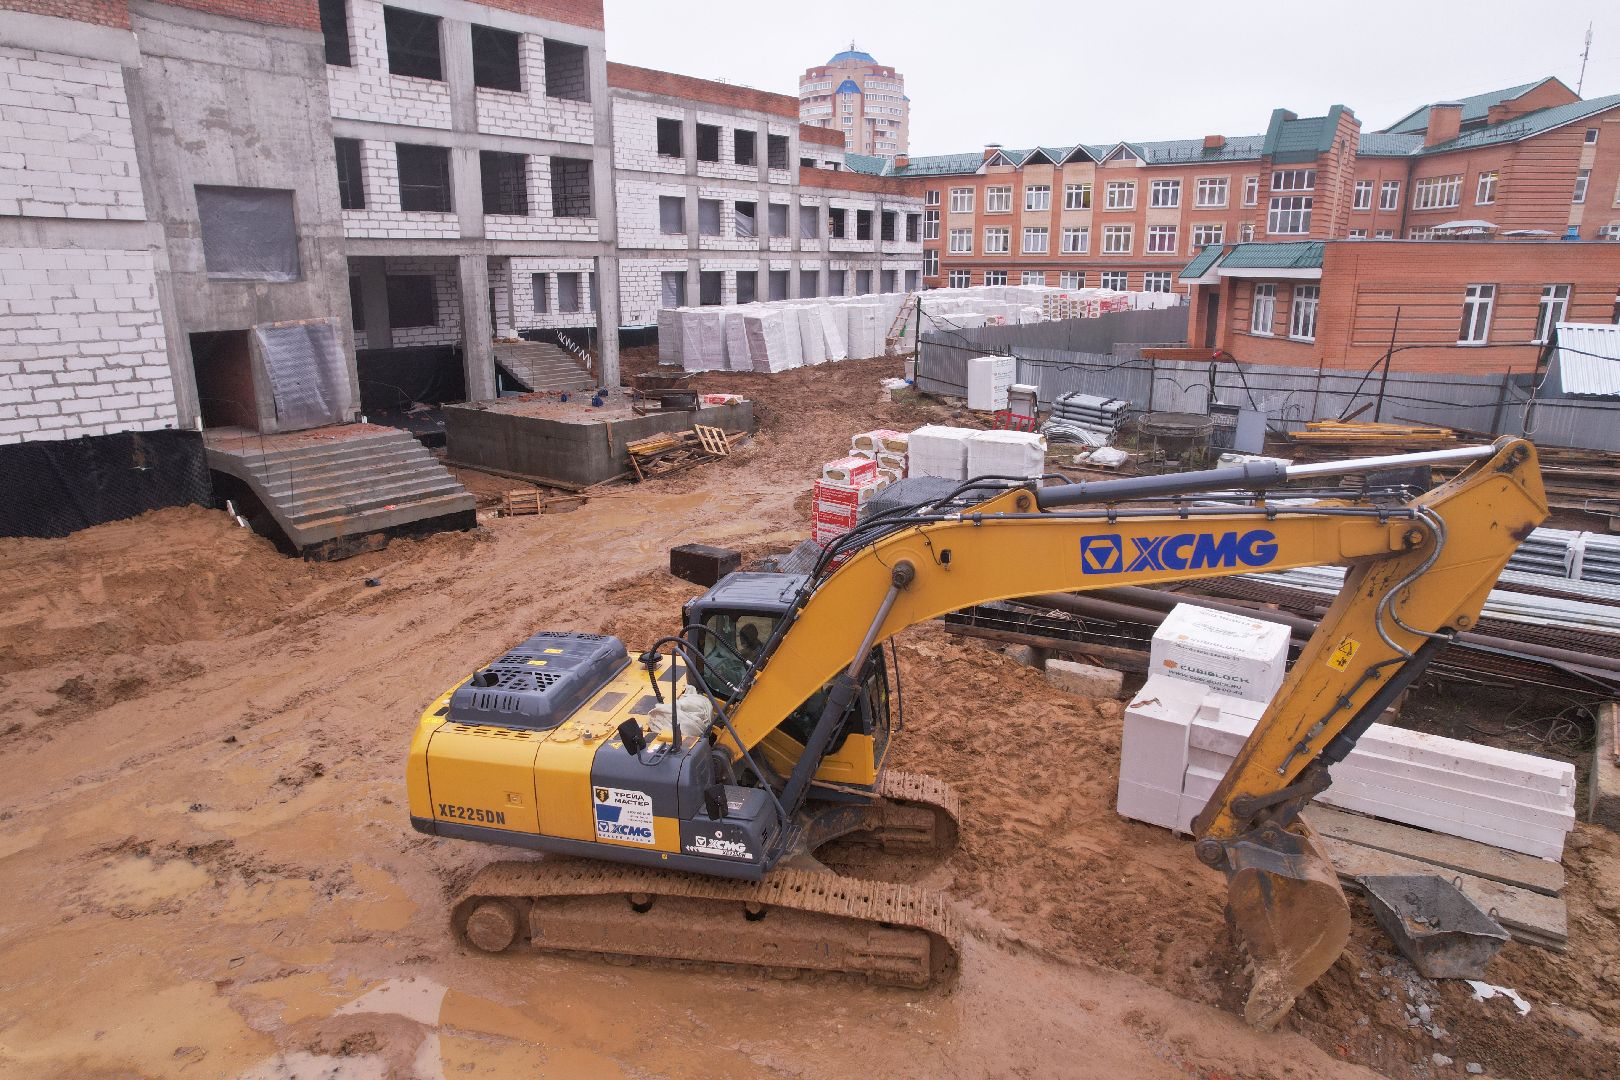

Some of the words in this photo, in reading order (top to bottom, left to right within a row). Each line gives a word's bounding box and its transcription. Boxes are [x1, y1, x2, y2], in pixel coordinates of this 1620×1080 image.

[1123, 529, 1279, 573] XCMG
[614, 798, 650, 807] МАСТЕР
[438, 803, 506, 825] XE225DN
[610, 823, 652, 838] XCMG
[706, 838, 747, 853] XCMG
